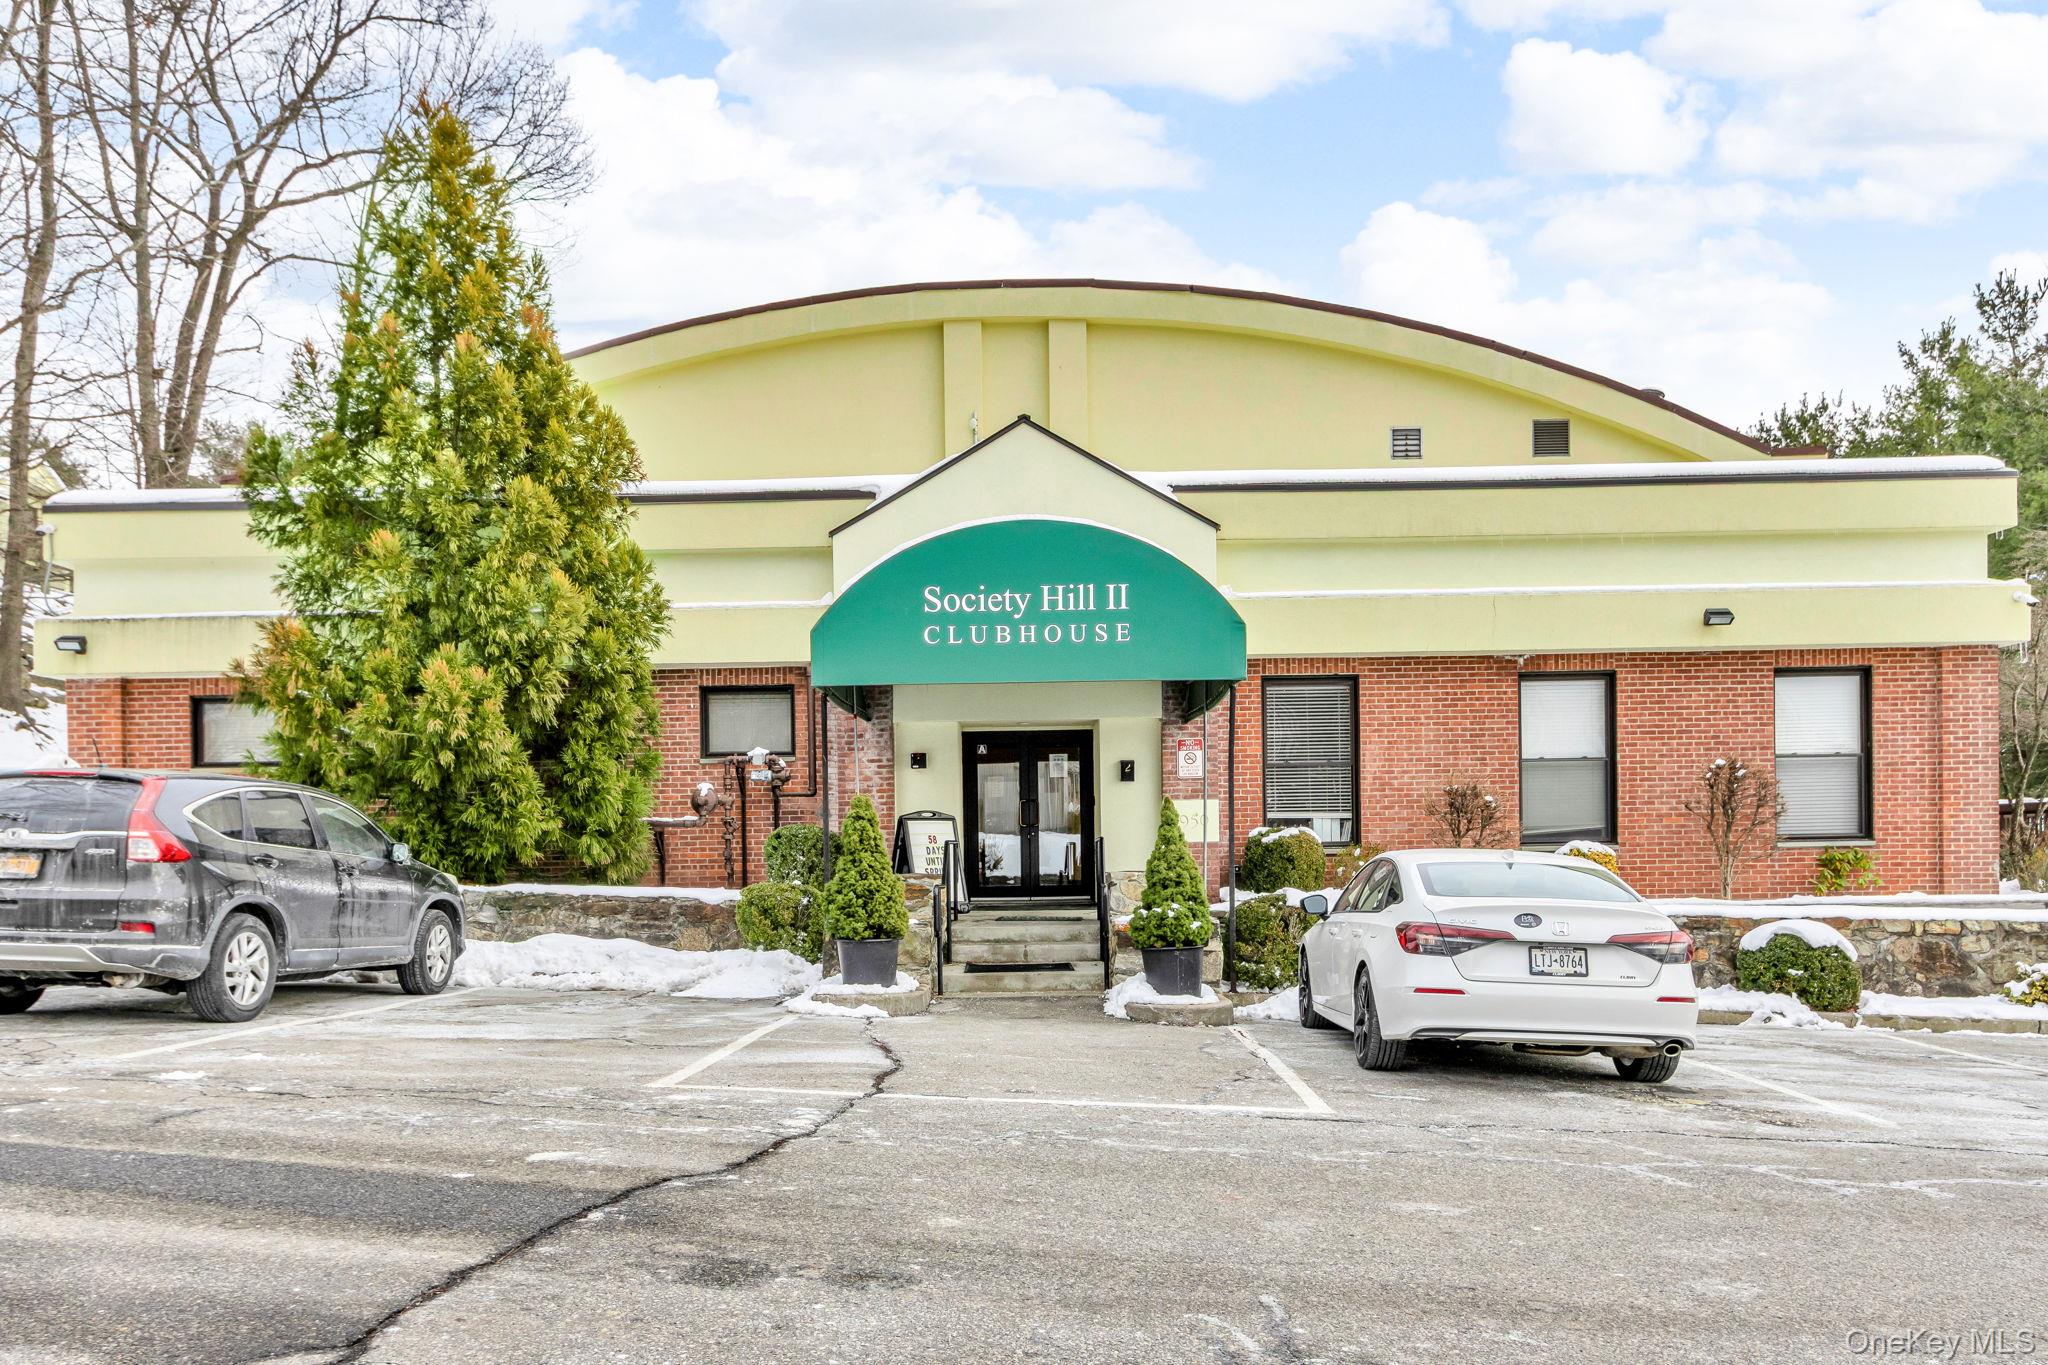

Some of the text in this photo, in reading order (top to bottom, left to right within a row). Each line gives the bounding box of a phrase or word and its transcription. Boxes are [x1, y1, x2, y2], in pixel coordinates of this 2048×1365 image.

[923, 583, 1129, 619] Society Hill II
[923, 623, 1131, 644] CLUBHOUSE
[1179, 814, 1209, 829] 950
[928, 835, 938, 844] 58
[926, 846, 944, 855] DAYS
[926, 857, 943, 866] UNTI
